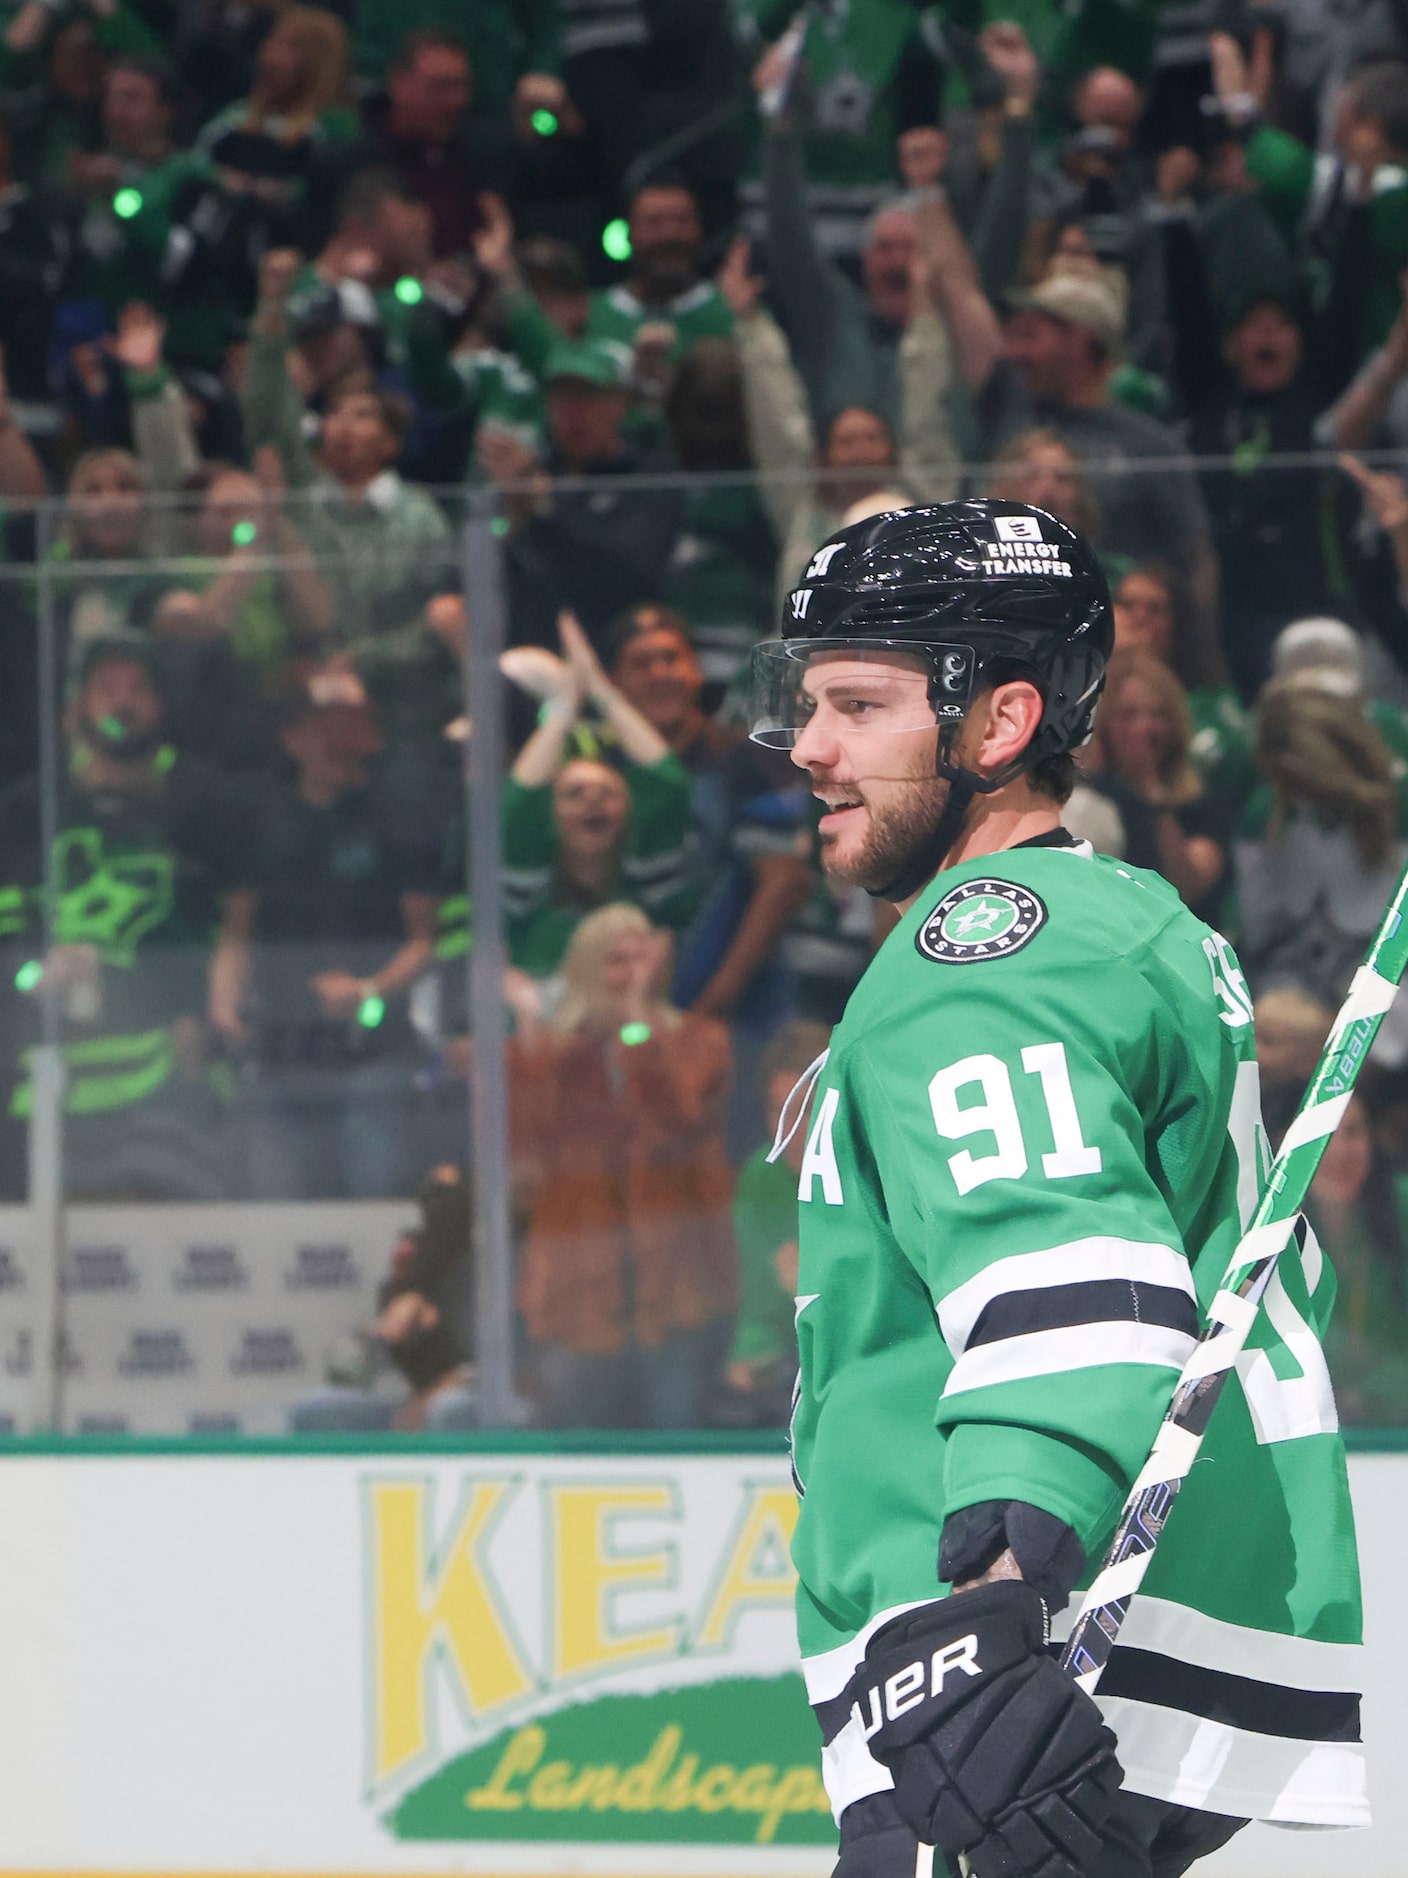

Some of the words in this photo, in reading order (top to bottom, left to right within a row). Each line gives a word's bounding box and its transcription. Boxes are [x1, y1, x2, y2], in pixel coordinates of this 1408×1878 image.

[981, 559, 1073, 578] TRANSFER
[988, 542, 1060, 559] ENERGY
[928, 884, 1033, 929] DALLAS
[934, 923, 1028, 955] STARS
[797, 1087, 844, 1206] A
[928, 1042, 1102, 1197] 91
[360, 1473, 802, 1804] KEA
[466, 1724, 832, 1843] Landscap
